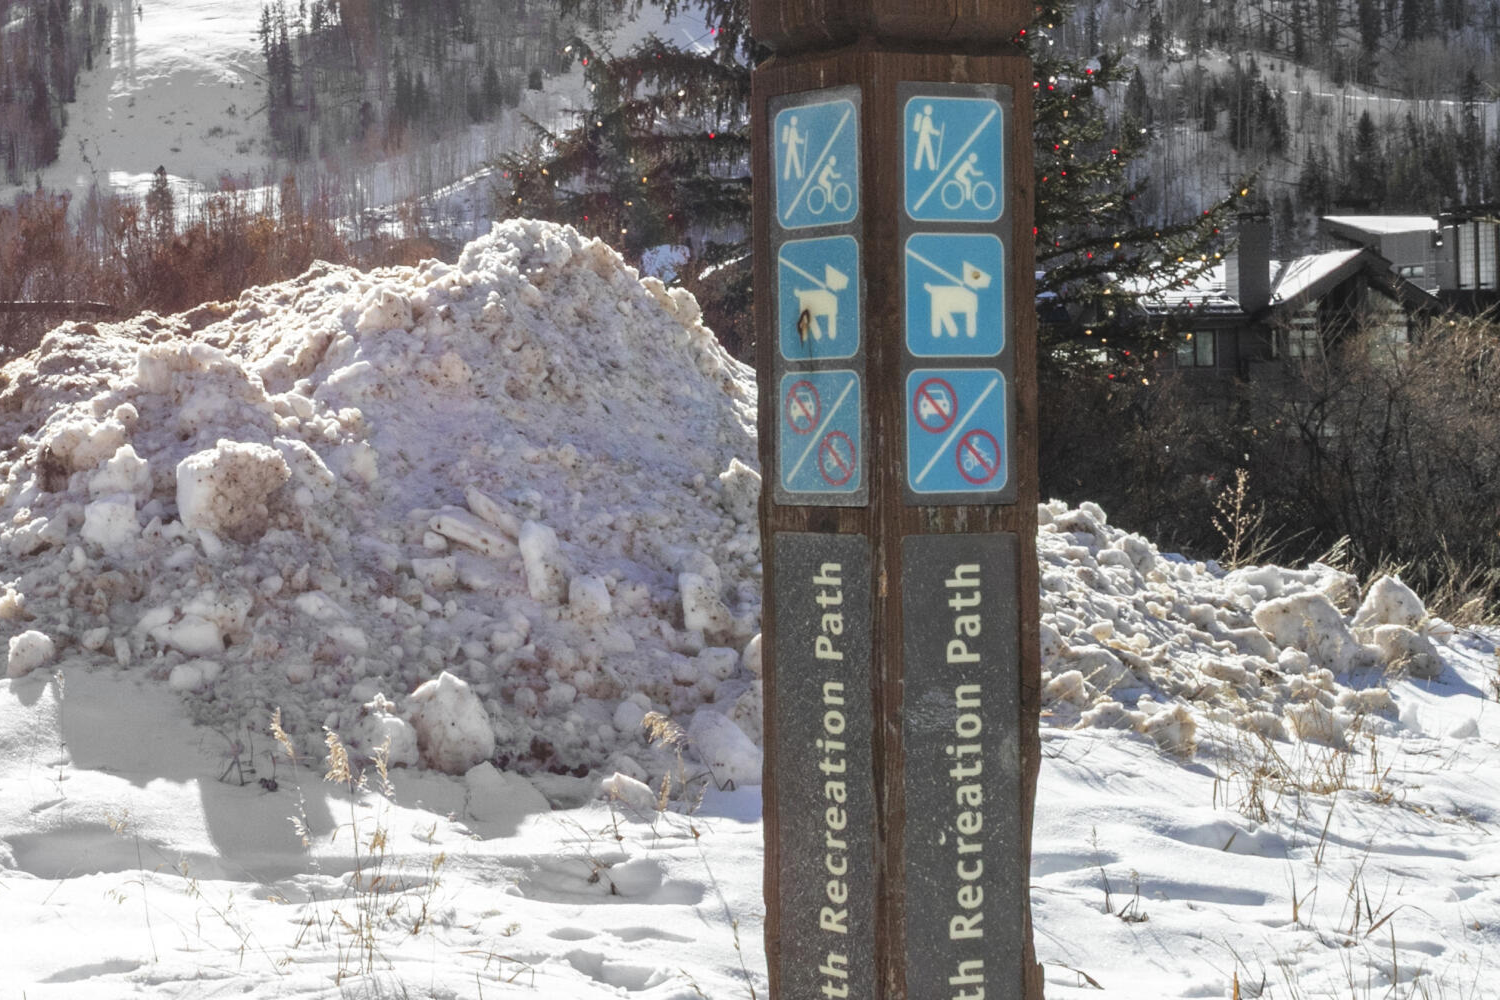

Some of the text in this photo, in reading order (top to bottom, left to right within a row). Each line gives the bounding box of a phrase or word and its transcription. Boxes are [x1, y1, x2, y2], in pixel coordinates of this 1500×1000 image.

[812, 562, 844, 661] Path
[945, 562, 981, 665] Path
[815, 681, 848, 935] Recreation
[945, 684, 984, 940] Recreation
